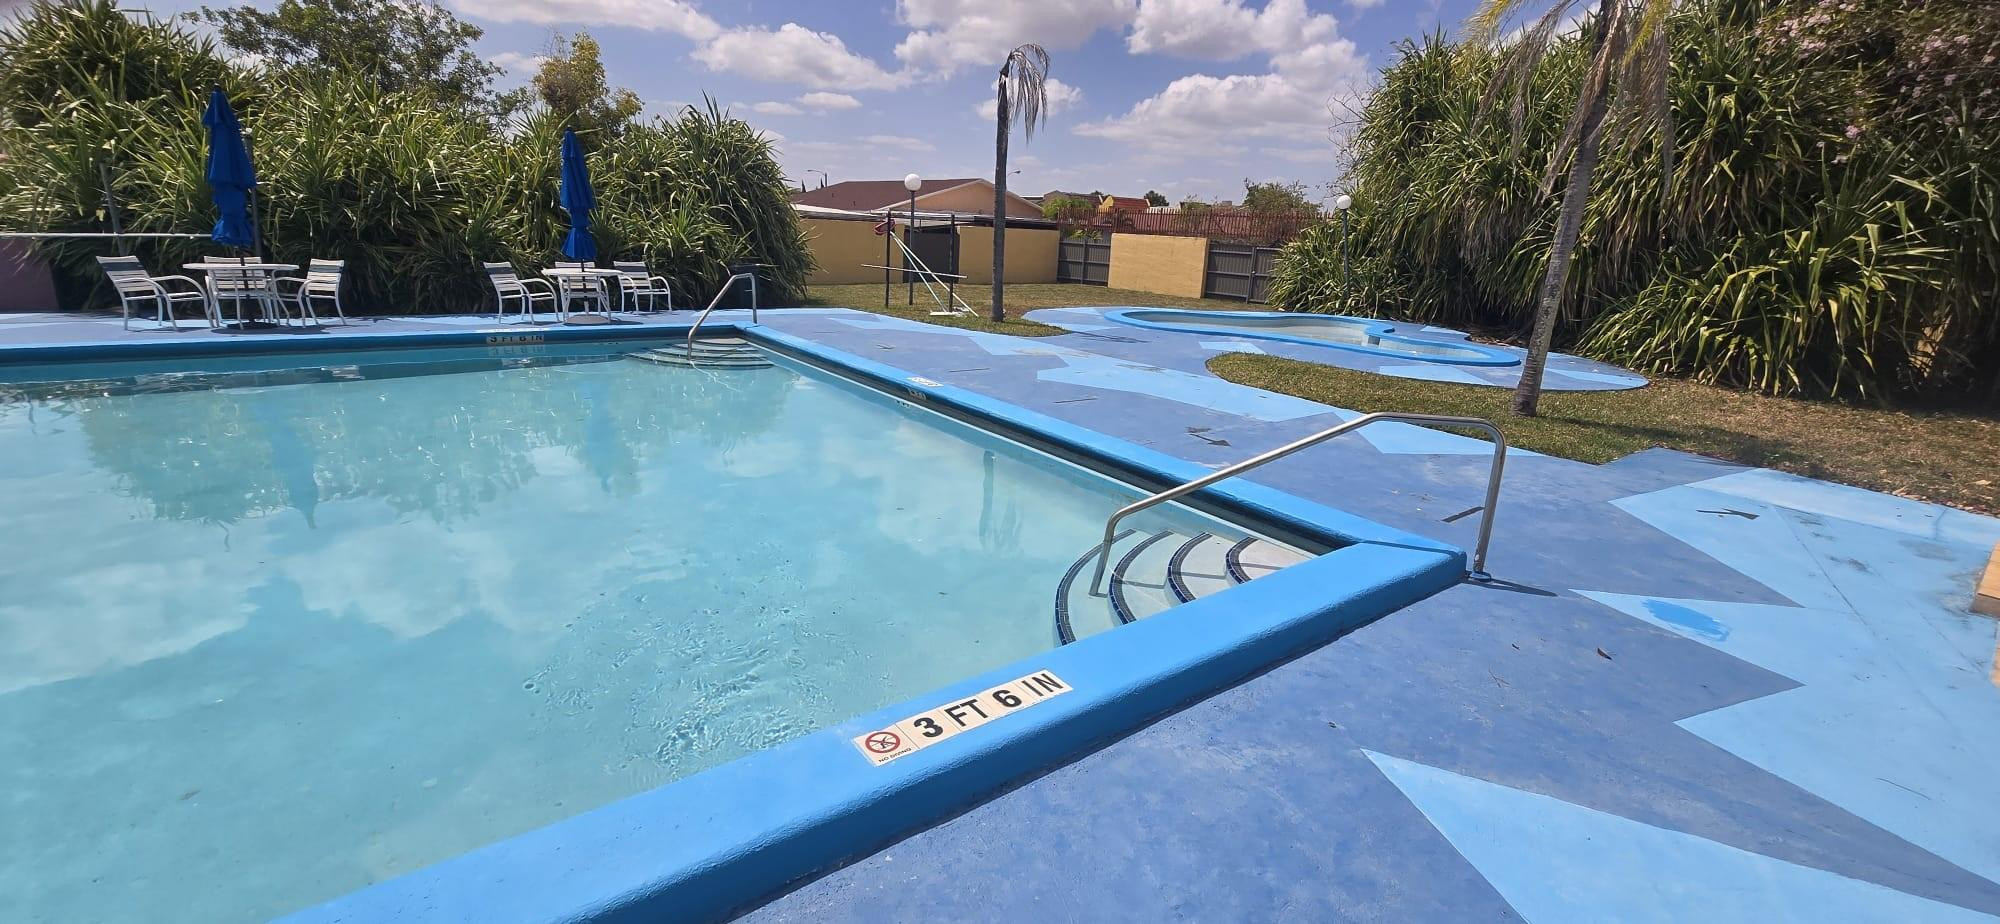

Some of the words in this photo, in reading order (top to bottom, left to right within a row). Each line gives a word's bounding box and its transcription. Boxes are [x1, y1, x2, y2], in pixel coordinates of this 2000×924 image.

[913, 717, 944, 738] 3
[944, 699, 988, 727] FT
[992, 689, 1022, 708] 6
[1022, 673, 1064, 697] IN
